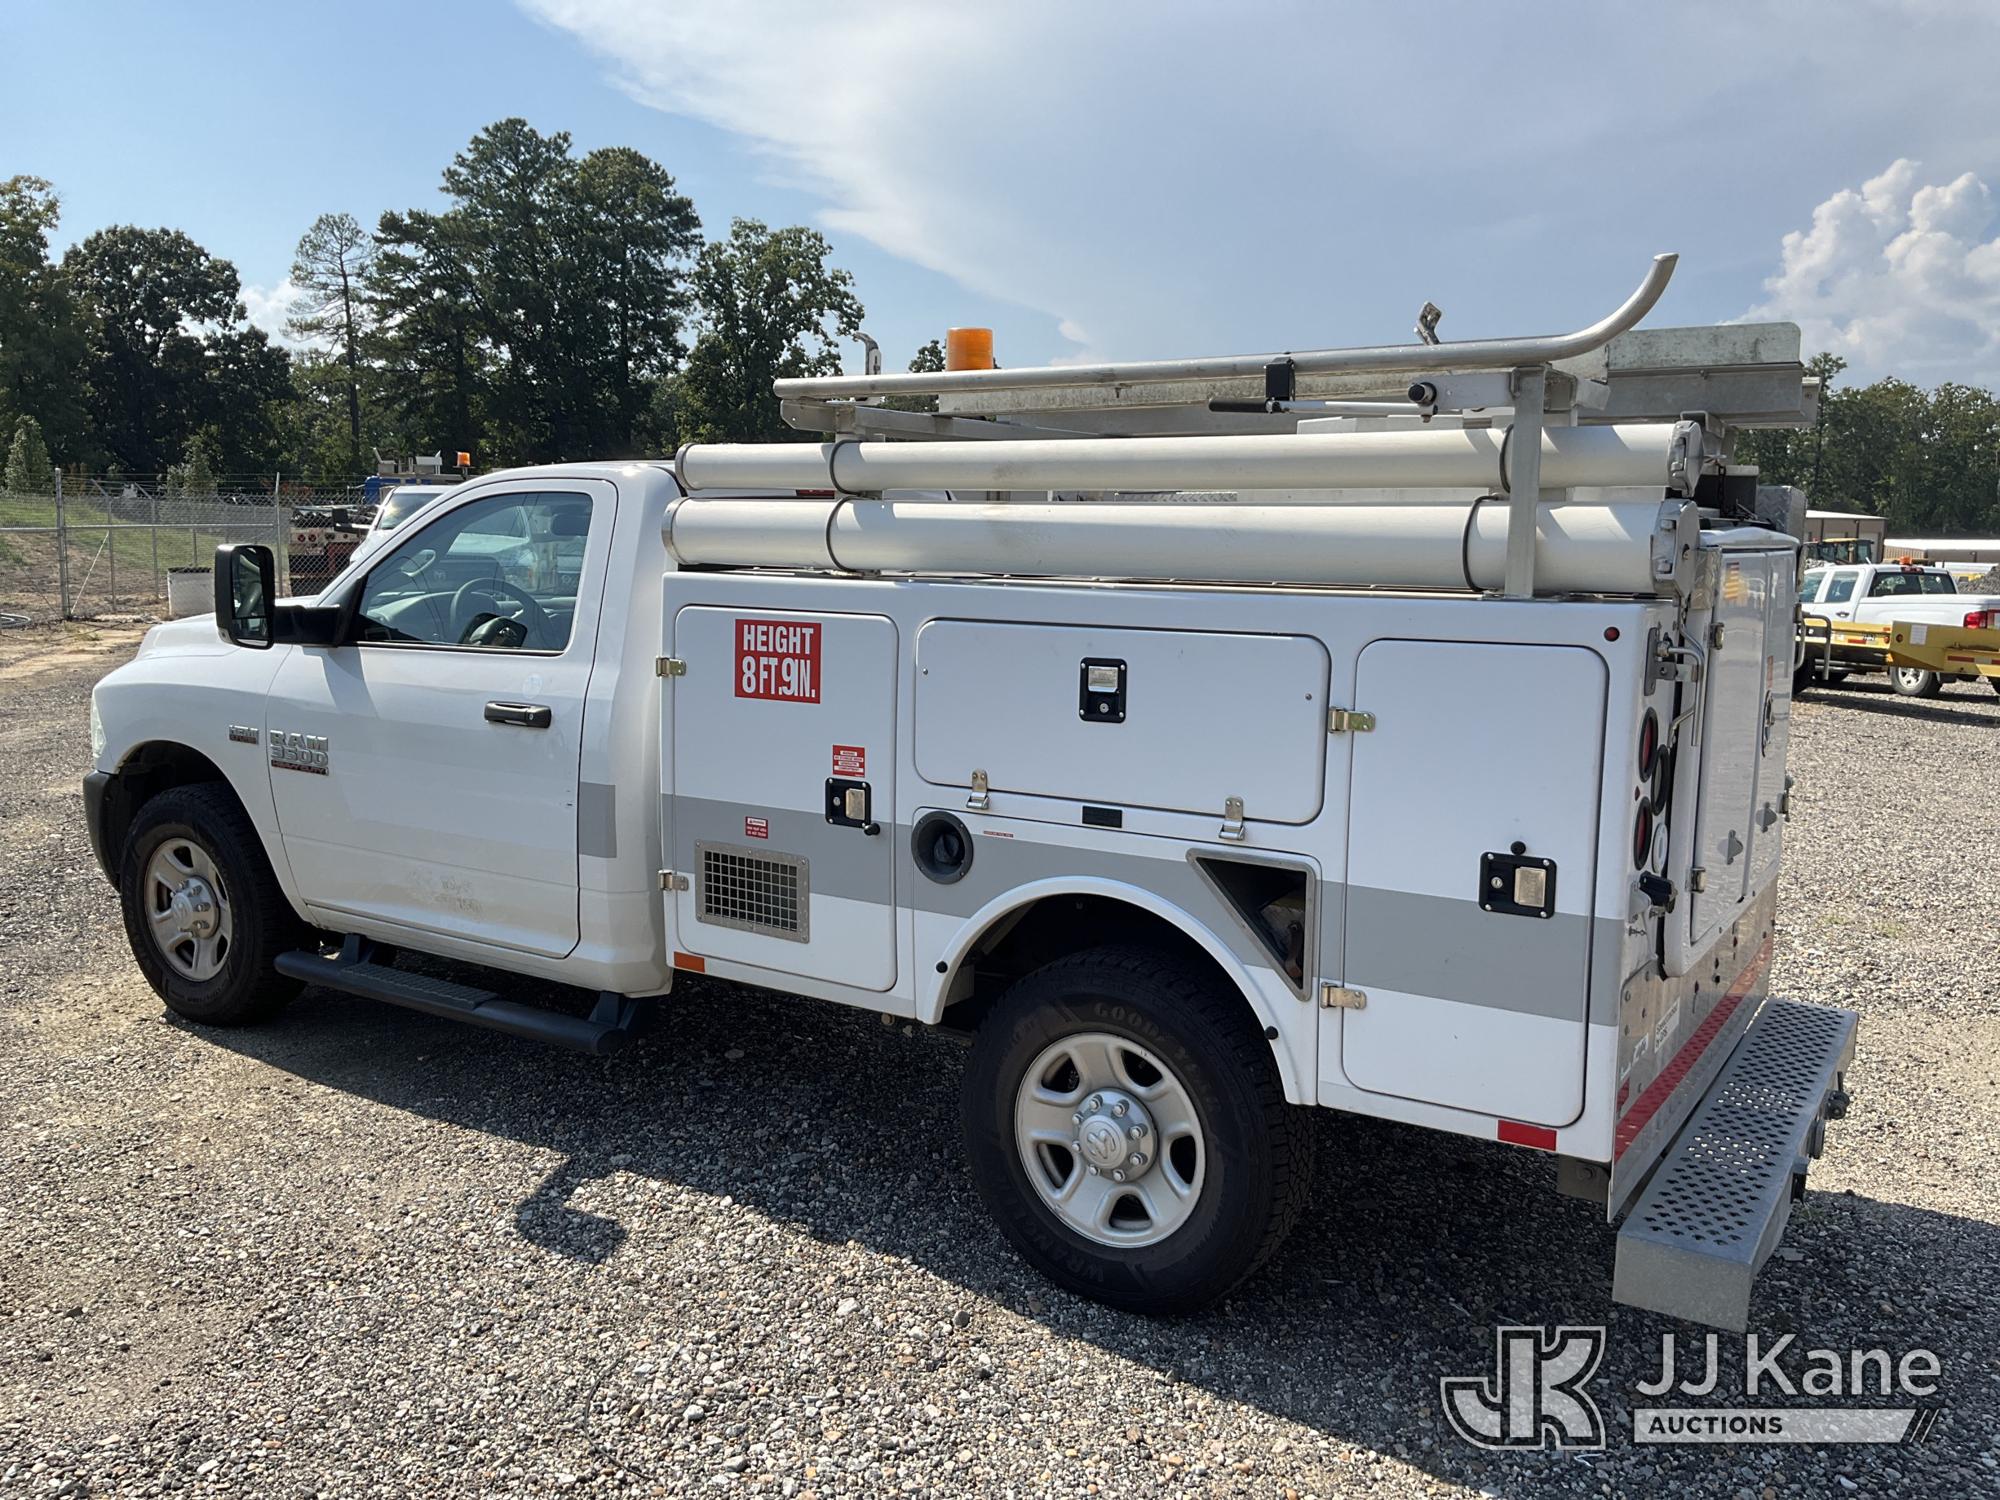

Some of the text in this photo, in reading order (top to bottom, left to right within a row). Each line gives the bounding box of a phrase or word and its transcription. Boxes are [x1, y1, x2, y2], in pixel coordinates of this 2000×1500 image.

[743, 624, 814, 655] HEIGHT
[270, 729, 328, 752] RAM
[270, 744, 328, 767] 3500
